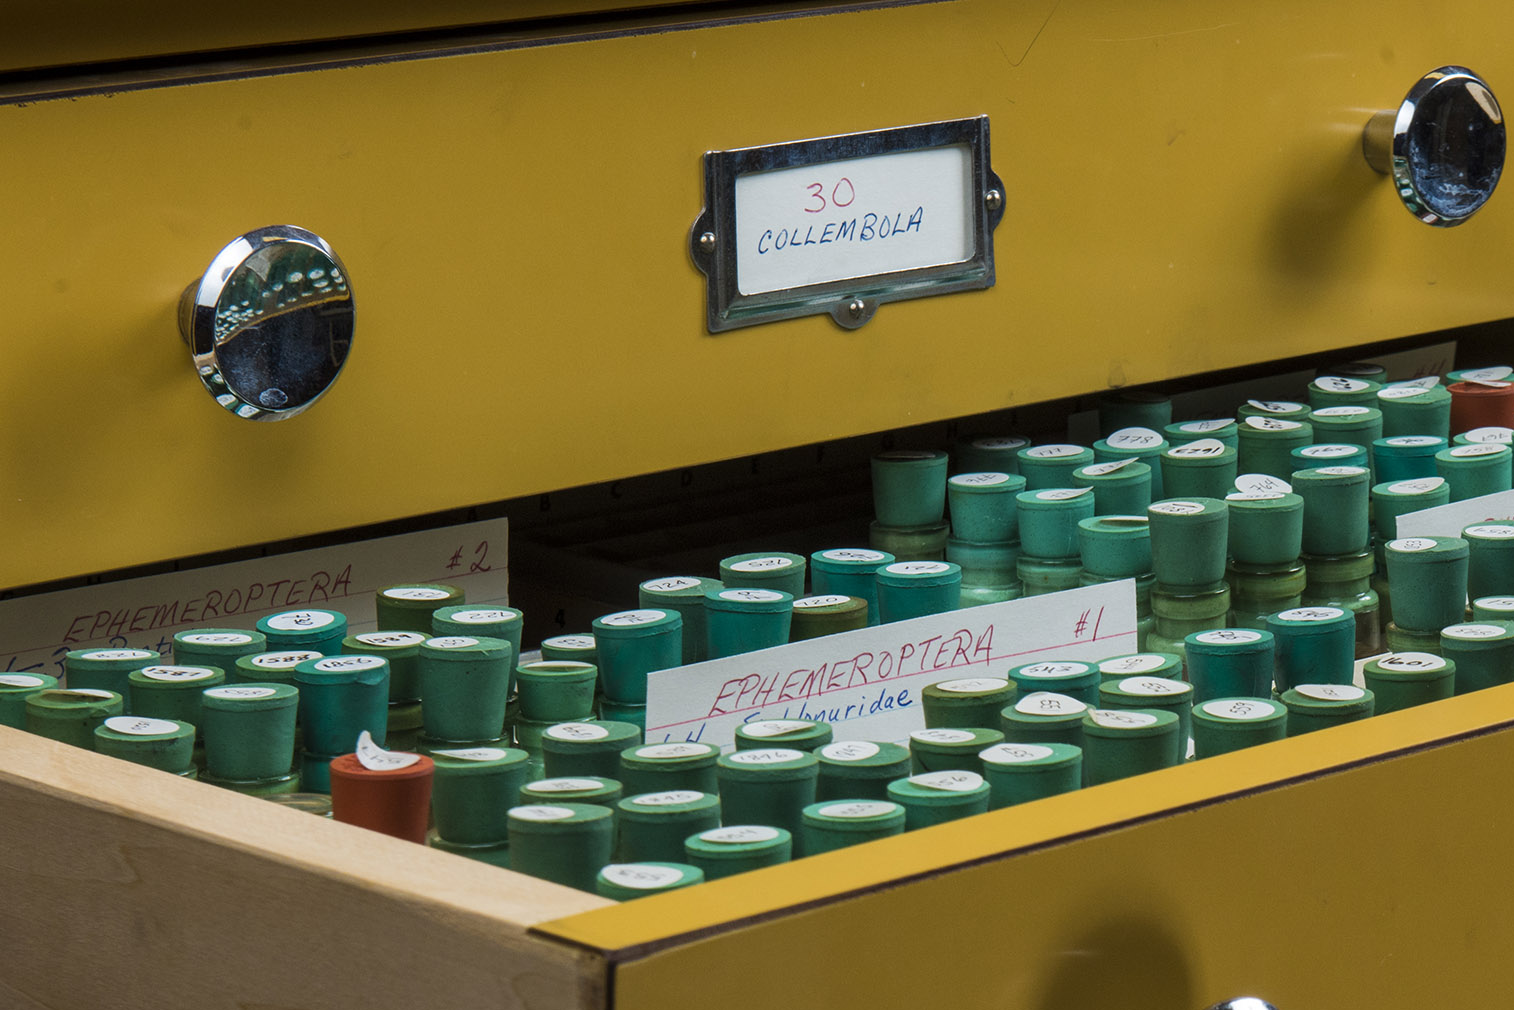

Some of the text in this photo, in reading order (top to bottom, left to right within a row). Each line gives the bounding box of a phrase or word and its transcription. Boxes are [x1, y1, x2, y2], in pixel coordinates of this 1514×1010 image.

[804, 177, 855, 213] 30
[758, 206, 923, 254] COLLEMBOLA
[1117, 435, 1154, 444] 778
[1250, 478, 1279, 493] 764
[648, 579, 686, 590] 724
[62, 564, 353, 644] EPHEMEROPTERA
[1074, 606, 1105, 641] #1
[709, 623, 995, 717] EPHEMEROPTERA
[1382, 656, 1434, 668] 1601
